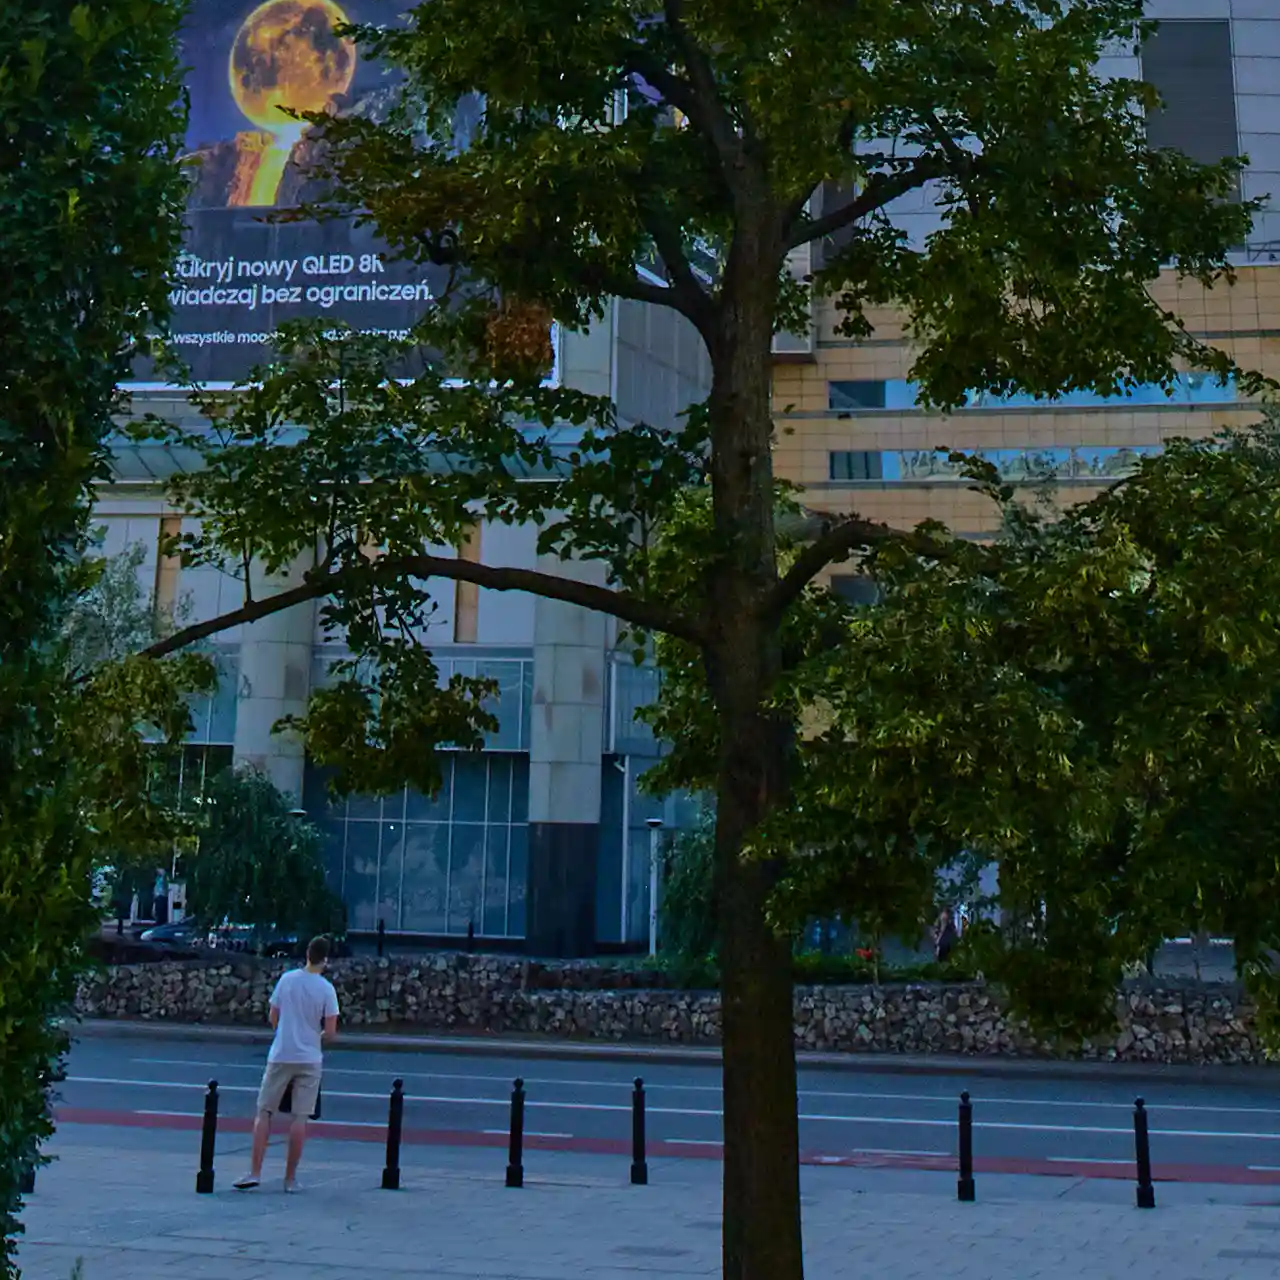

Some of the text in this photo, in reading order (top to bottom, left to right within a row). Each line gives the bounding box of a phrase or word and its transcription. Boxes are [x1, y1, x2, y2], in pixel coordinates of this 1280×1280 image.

[238, 260, 298, 282] nowy
[303, 255, 354, 276] QLED
[262, 284, 302, 304] bez
[306, 278, 434, 309] ograniczeń.
[173, 329, 236, 348] wszystkie
